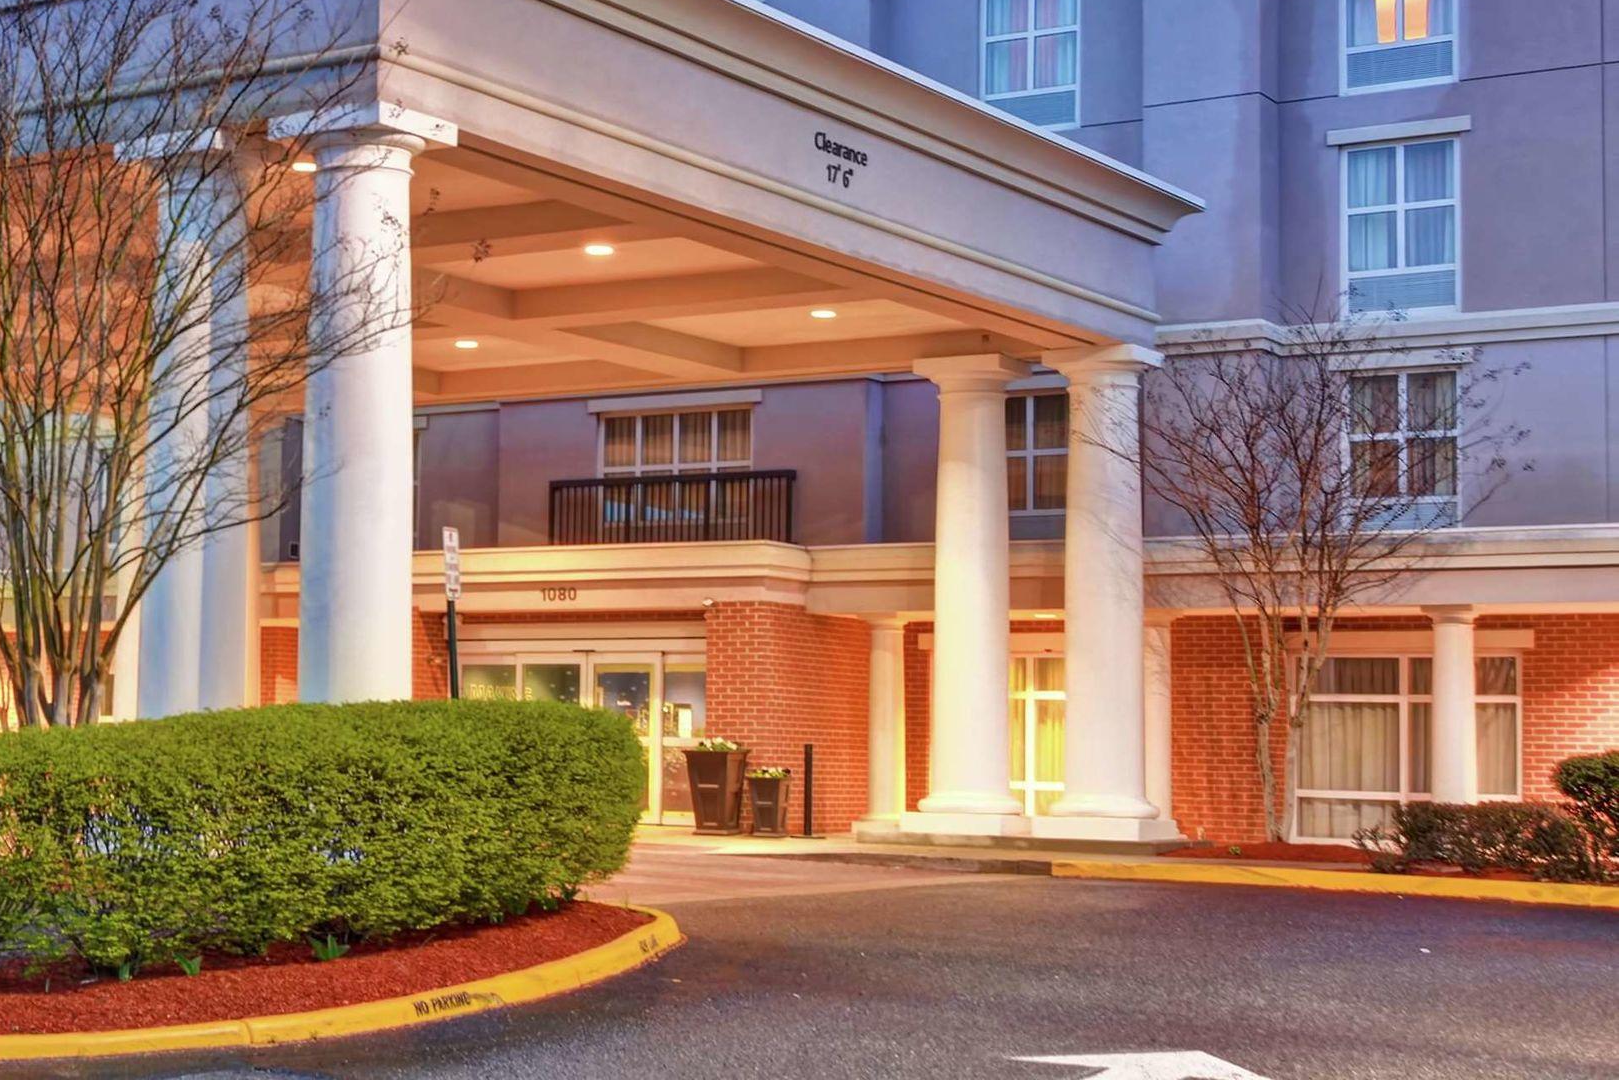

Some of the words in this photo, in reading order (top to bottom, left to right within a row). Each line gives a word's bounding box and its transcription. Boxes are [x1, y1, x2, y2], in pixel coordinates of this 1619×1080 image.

[814, 131, 868, 167] Clearance
[540, 587, 577, 602] 1080
[413, 999, 430, 1018] NO
